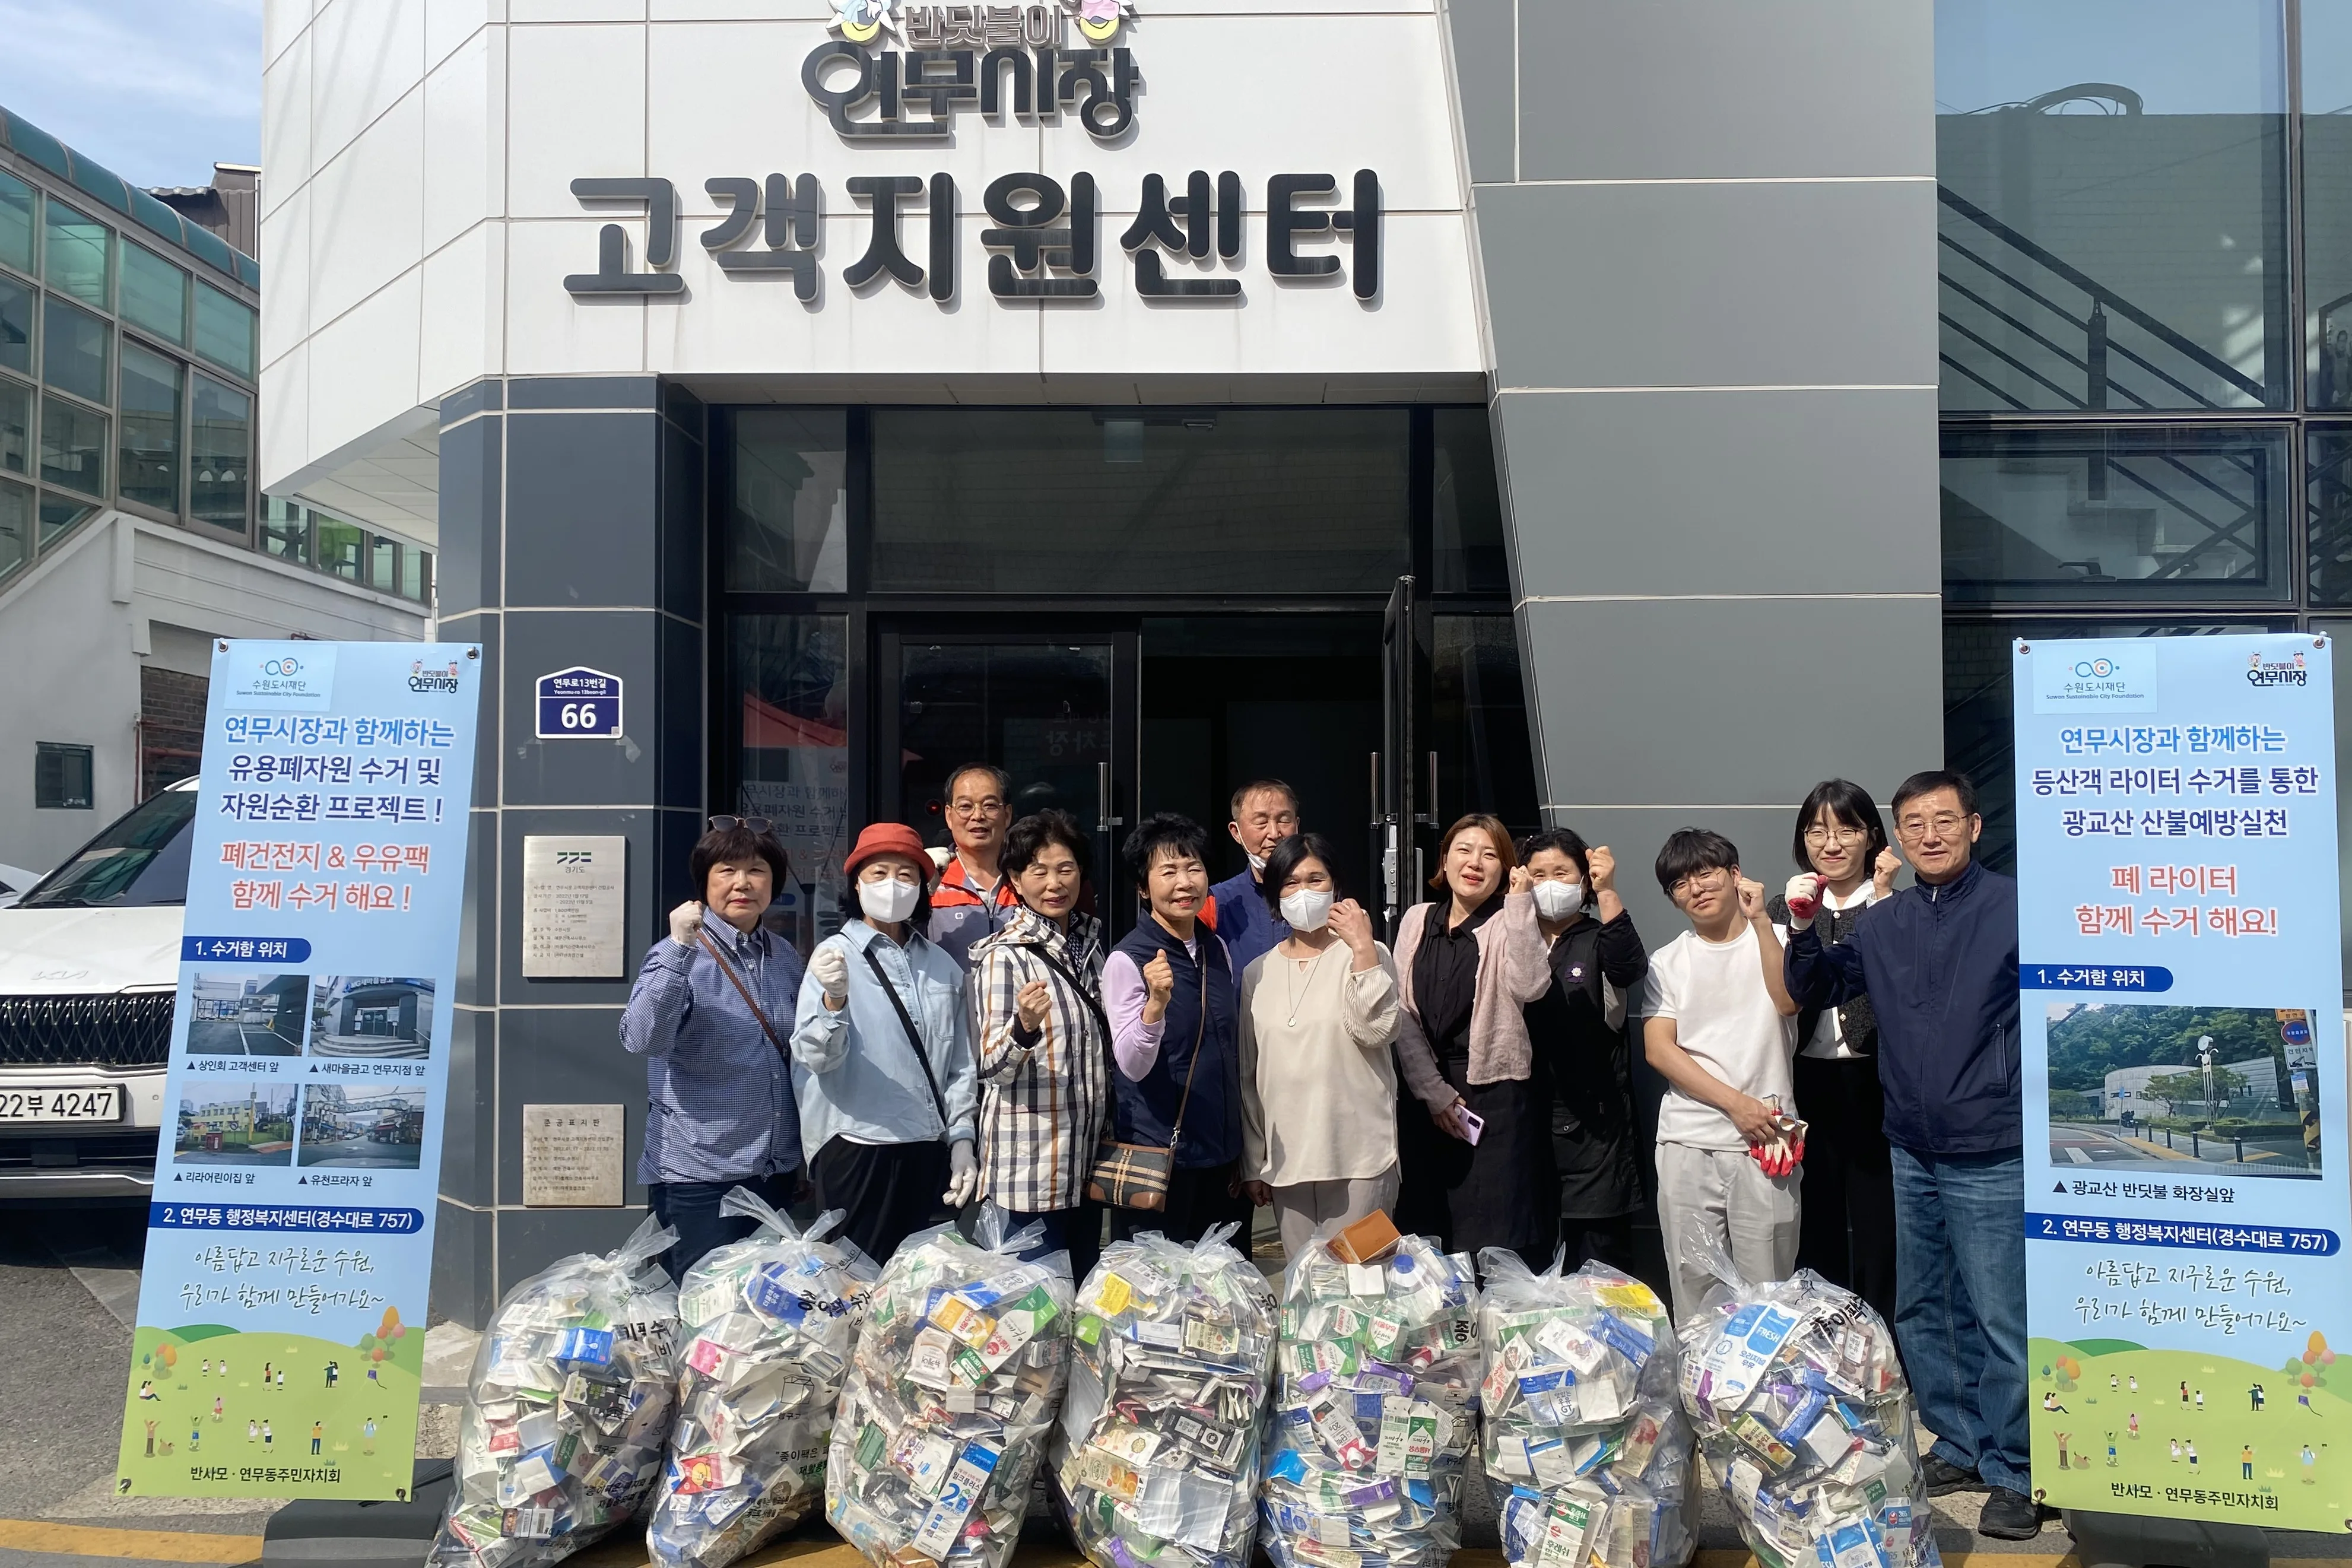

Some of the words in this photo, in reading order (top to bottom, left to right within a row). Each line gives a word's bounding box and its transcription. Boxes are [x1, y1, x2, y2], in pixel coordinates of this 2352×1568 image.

[903, 5, 1065, 49] 반딧불이
[801, 40, 1141, 139] 연무시장
[563, 169, 1380, 303] 고객지원센터
[252, 680, 306, 691] 수원도시재단
[408, 677, 458, 694] 연무시장
[554, 678, 606, 688] 연무로13번길
[2064, 681, 2125, 693] 수원도시재단
[2247, 669, 2307, 687] 연무시장
[561, 703, 596, 729] 66
[225, 716, 348, 745] 연무시장과
[356, 718, 455, 747] 함께하는
[2061, 726, 2181, 754] 연무시장과
[2186, 725, 2286, 751] 함께하는
[228, 755, 351, 783] 유용폐자원
[359, 757, 407, 785] 수거
[417, 760, 440, 788] 및
[2032, 769, 2102, 795] 등산객
[2110, 768, 2180, 795] 라이터
[2188, 768, 2262, 794] 수거를
[2269, 767, 2319, 793] 통한
[745, 785, 800, 799] 무시장과
[805, 786, 846, 800] 함께하
[221, 793, 319, 821] 자원순환
[326, 796, 426, 823] 프로젝트
[2062, 810, 2134, 836] 광교산
[2141, 810, 2288, 836] 산불예방실천
[221, 842, 320, 870] 폐건전지
[327, 846, 345, 868] &
[353, 845, 429, 874] 우유팩
[2112, 866, 2140, 894] 폐
[2150, 866, 2236, 895] 라이터
[233, 881, 281, 909] 함께
[287, 883, 337, 910] 수거
[345, 884, 395, 911] 해요
[2076, 906, 2133, 935] 함께
[2141, 907, 2198, 936] 수거
[2208, 907, 2277, 937] 해요!
[196, 942, 207, 956] 1.
[211, 941, 255, 958] 수거함
[258, 942, 287, 958] 위치
[2037, 970, 2052, 985] 1.
[2057, 969, 2107, 986] 수거함
[2112, 970, 2145, 987] 위치
[198, 1061, 226, 1071] 상인회
[230, 1061, 266, 1072] 고객센터
[269, 1062, 278, 1072] 앞
[322, 1062, 369, 1075] 새마을금고
[373, 1064, 412, 1075] 연무지점
[415, 1065, 425, 1077] 앞
[51, 1093, 112, 1116] 4247
[186, 1172, 242, 1184] 리라어린이집
[245, 1173, 255, 1184] 앞
[310, 1175, 360, 1186] 유천프라자
[362, 1176, 372, 1186] 앞
[2072, 1180, 2118, 1196] 광교산
[2122, 1182, 2168, 1199] 반딧불
[2173, 1185, 2235, 1203] 화장실앞
[163, 1208, 175, 1223] 2.
[180, 1207, 222, 1225] 연무동
[226, 1209, 373, 1229] 행정복지센터(경수대로
[379, 1213, 412, 1229] 757)
[2043, 1220, 2058, 1234] 2.
[2062, 1219, 2110, 1237] 연무동
[2115, 1222, 2285, 1248] 행정복지센터(경수대로
[2290, 1233, 2328, 1251] 757)
[195, 1246, 261, 1273] 아름답고
[268, 1248, 328, 1274] 지구로운
[334, 1249, 375, 1276] 수원,
[2086, 1259, 2160, 1288] 아름답고
[2169, 1265, 2236, 1292] 지구로운
[2244, 1269, 2292, 1297] 수원,
[180, 1284, 231, 1310] 우리가
[237, 1283, 279, 1309] 함께
[2075, 1296, 2132, 1325] 우리가
[2140, 1300, 2186, 1325] 함께
[1757, 1325, 1781, 1343] FRESH
[191, 1467, 228, 1481] 반사모
[240, 1467, 341, 1483] 연무동주민자치회
[2110, 1483, 2153, 1499] 반사모
[2165, 1487, 2278, 1511] 연무동주민자치회
[1546, 1540, 1570, 1557] 후레쉬
